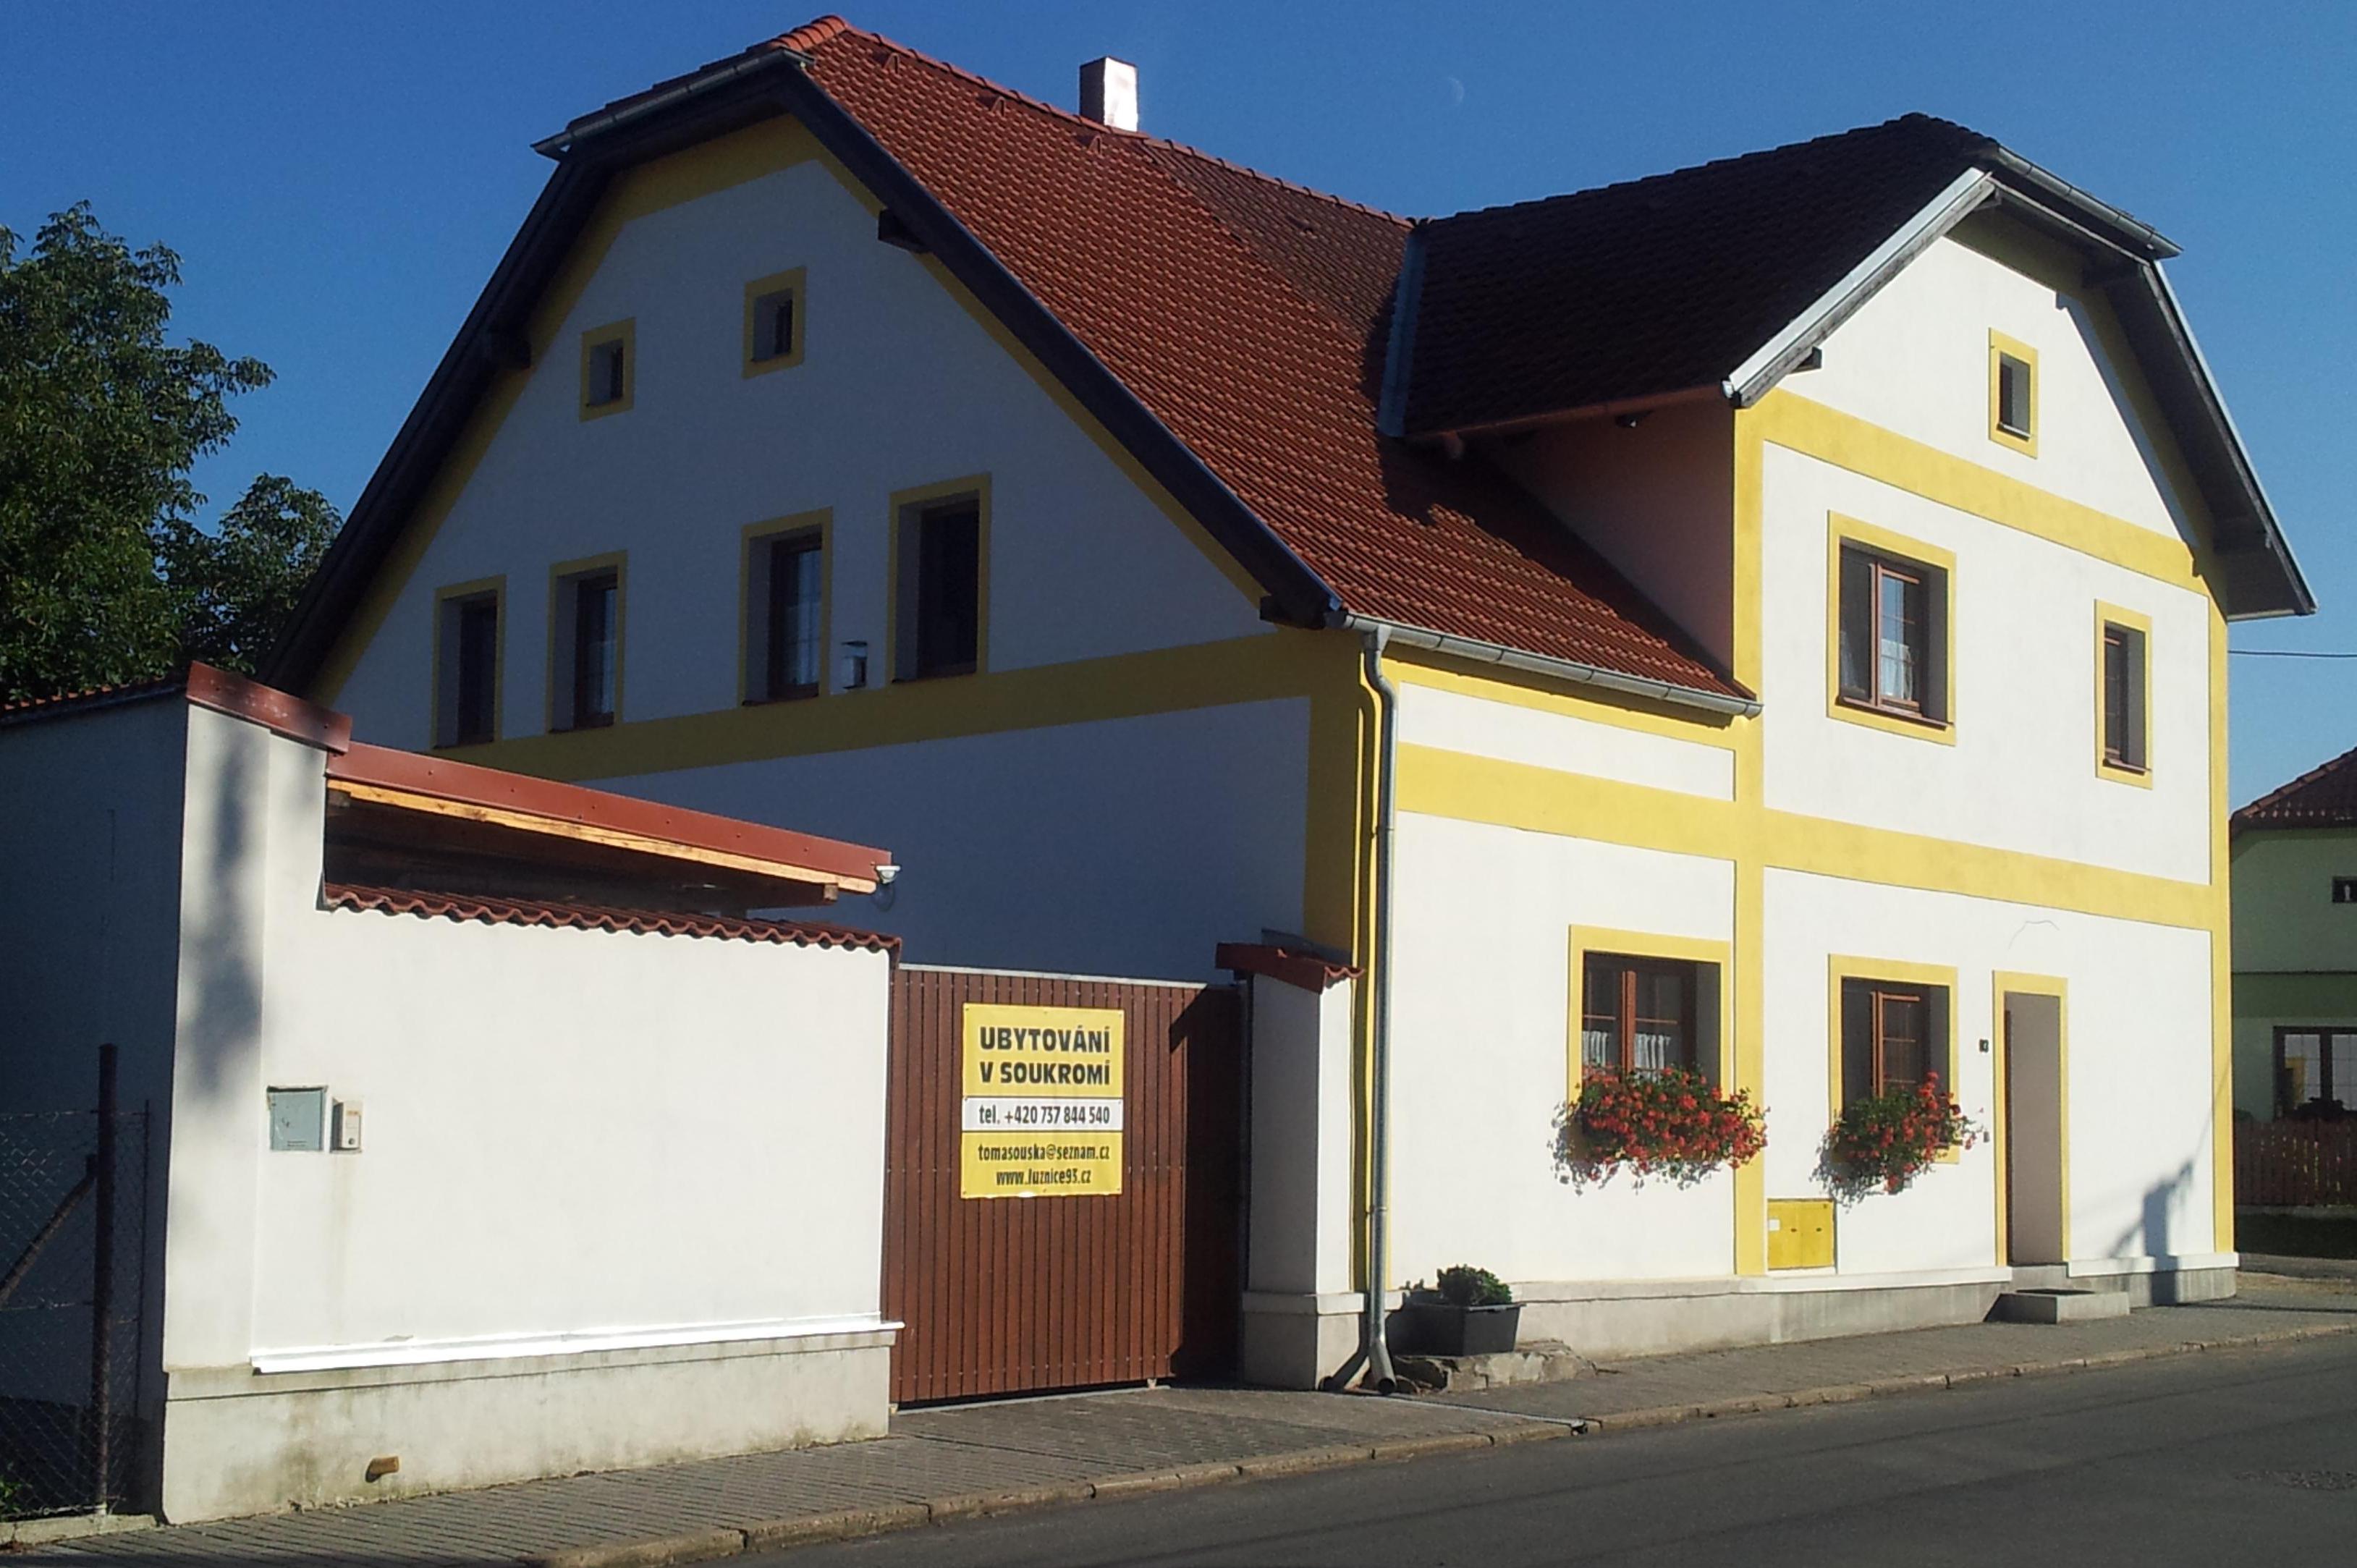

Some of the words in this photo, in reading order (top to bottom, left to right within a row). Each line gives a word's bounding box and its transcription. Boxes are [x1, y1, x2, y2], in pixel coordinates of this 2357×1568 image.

[980, 1025, 1110, 1053] UBYTOVÁNÍ
[980, 1061, 994, 1083] V
[1000, 1059, 1110, 1085] SOUKROMÍ
[979, 1104, 1000, 1124] tel.
[1004, 1106, 1038, 1124] +420
[1041, 1106, 1061, 1124] 737
[1064, 1106, 1086, 1124] 844
[1088, 1106, 1110, 1124] 540
[978, 1143, 1109, 1161] tomasouska@seznam.cz
